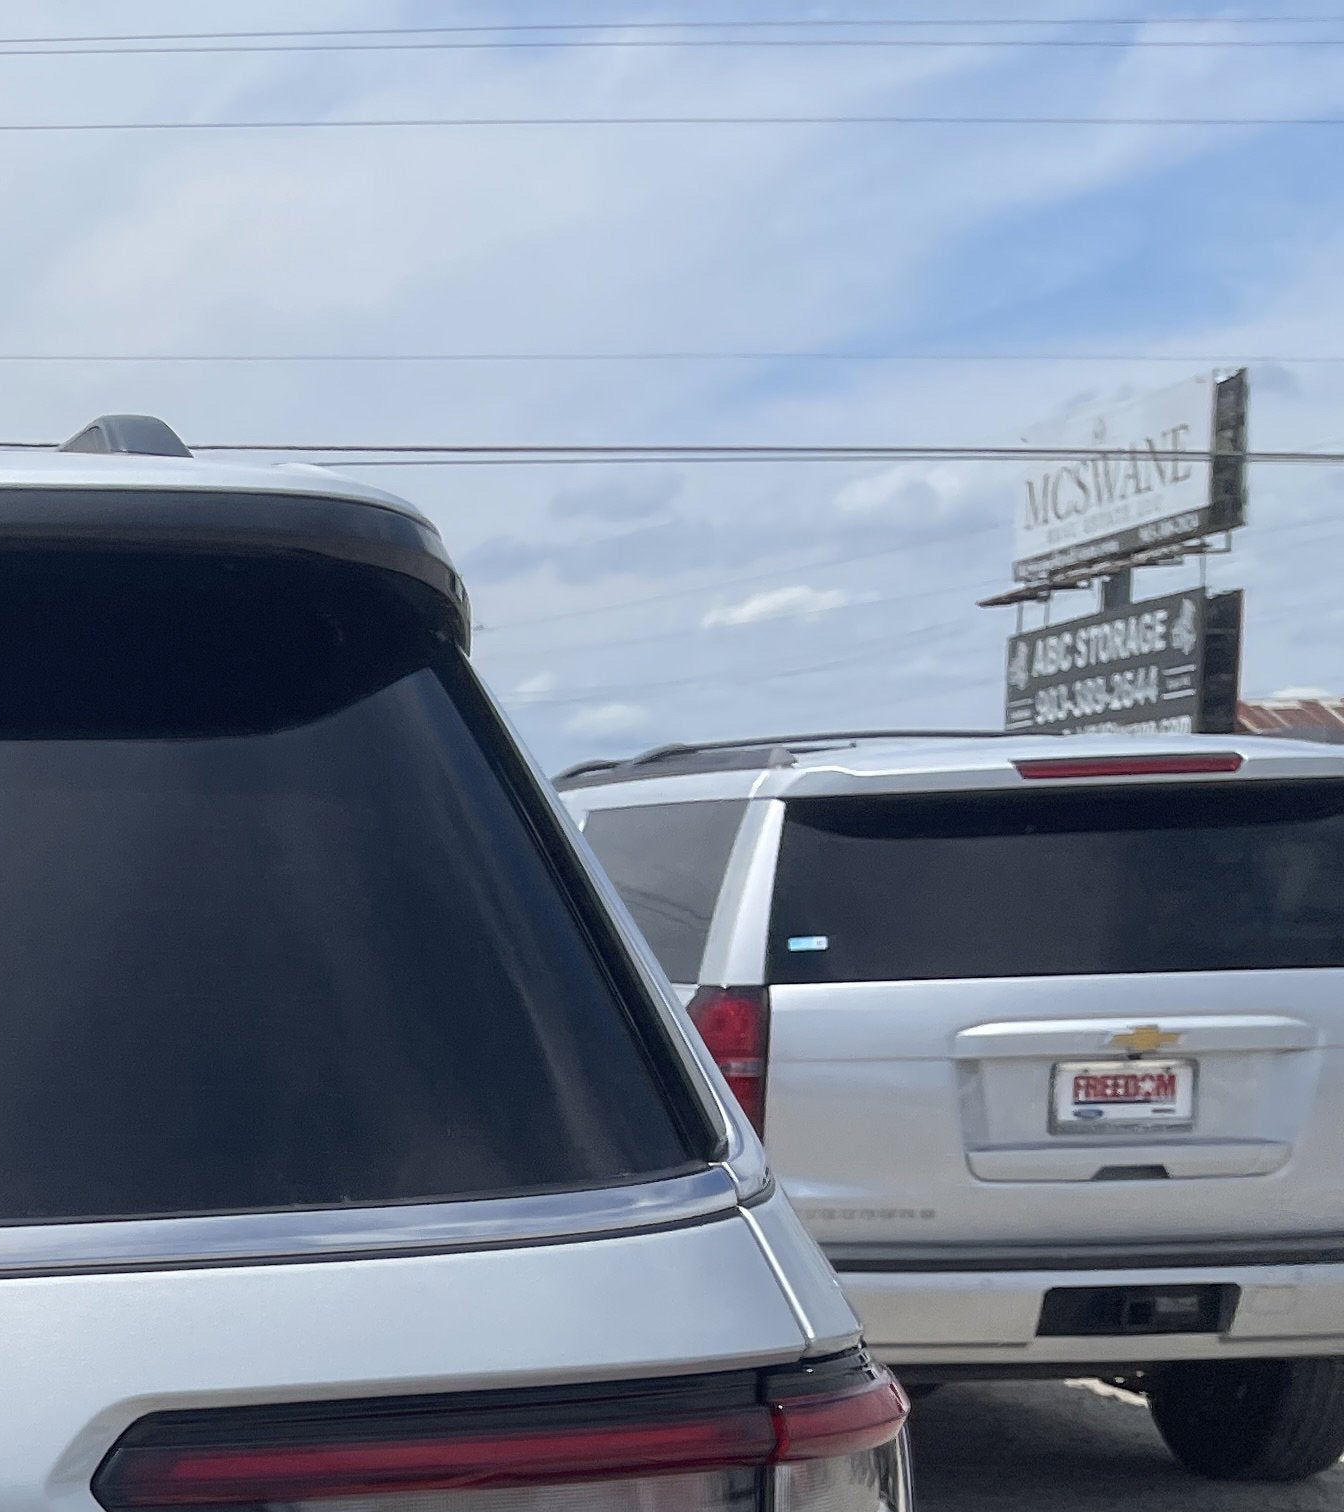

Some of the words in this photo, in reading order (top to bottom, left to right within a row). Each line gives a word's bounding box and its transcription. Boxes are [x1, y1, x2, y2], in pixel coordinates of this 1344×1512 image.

[1031, 631, 1074, 677] ABC
[1074, 609, 1169, 669] STORAGE
[1073, 1073, 1177, 1101] FREEDOM
